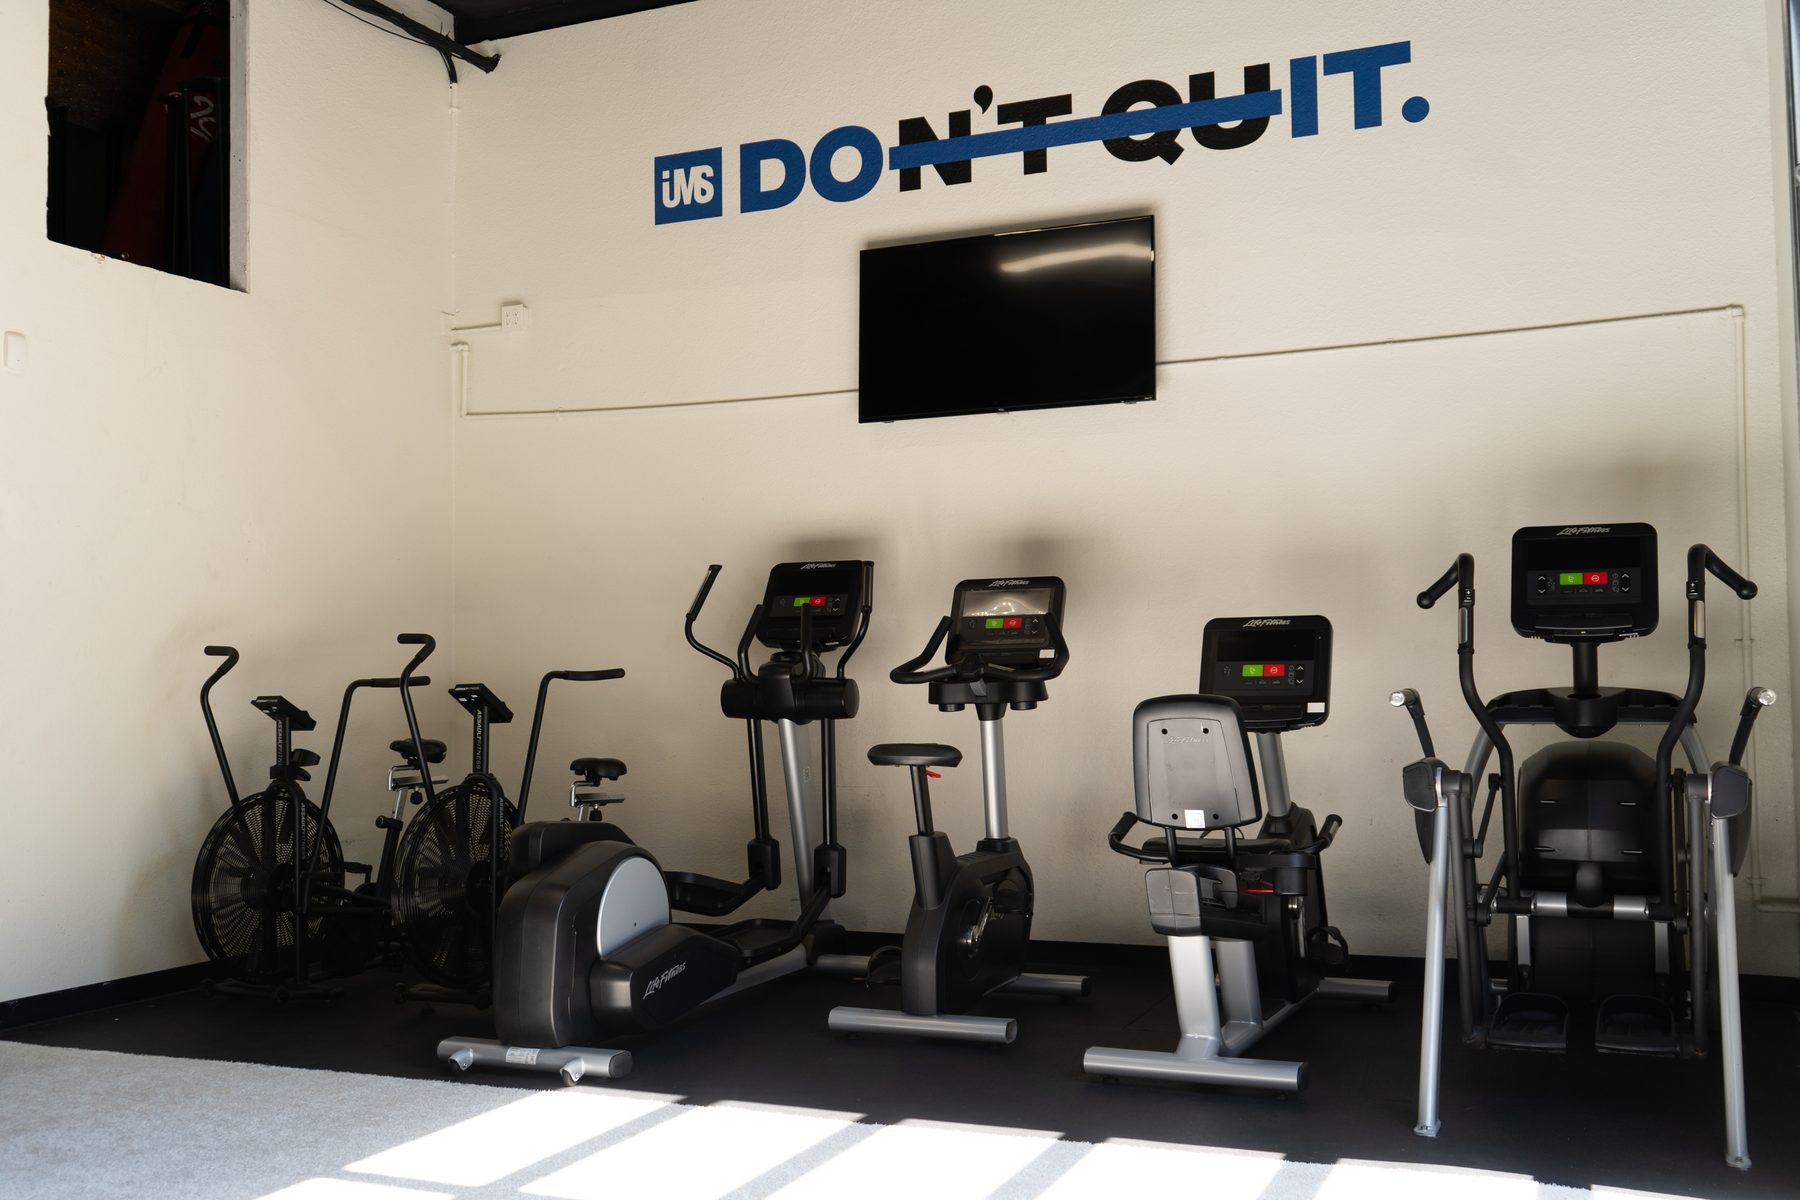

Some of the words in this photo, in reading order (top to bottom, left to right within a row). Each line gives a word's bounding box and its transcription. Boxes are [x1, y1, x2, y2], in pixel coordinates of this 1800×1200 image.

[740, 85, 1072, 214] DON'T
[1100, 41, 1430, 166] QUIT.
[643, 976, 661, 1001] Life
[659, 961, 687, 989] Fitness
